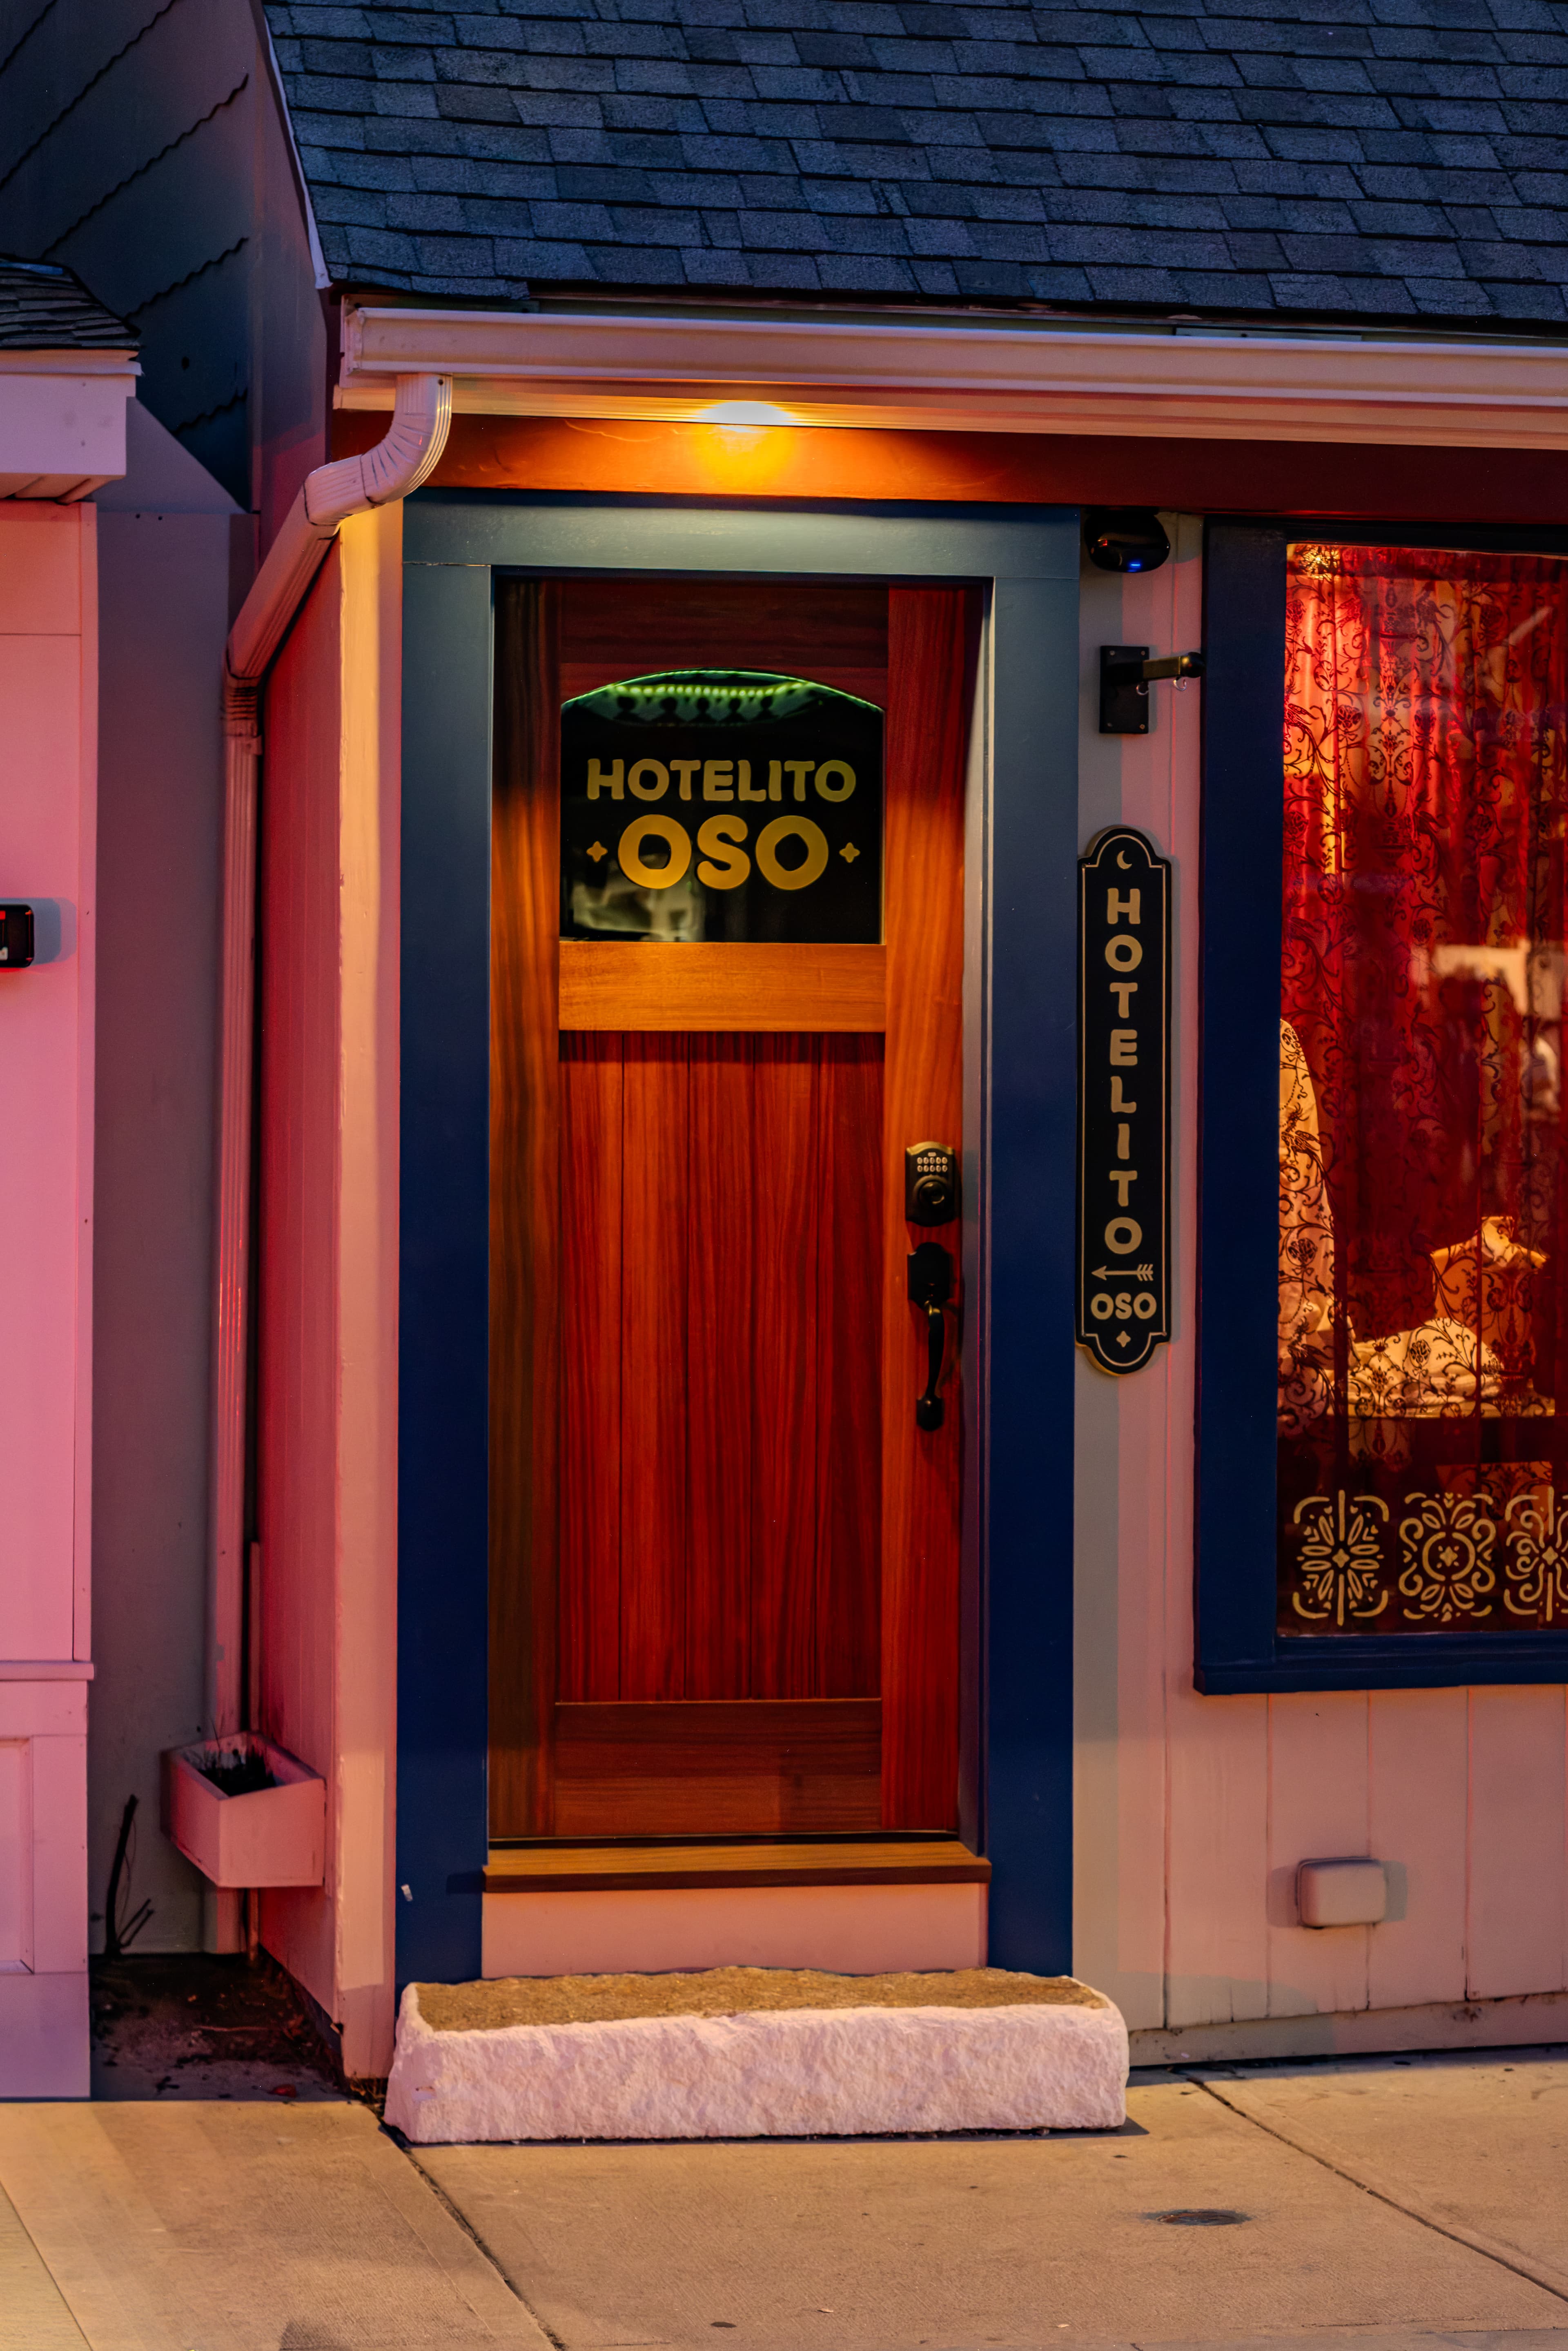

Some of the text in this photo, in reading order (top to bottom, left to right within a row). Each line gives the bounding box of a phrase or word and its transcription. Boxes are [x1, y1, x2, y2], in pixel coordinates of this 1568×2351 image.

[587, 758, 856, 802] HOTELITO
[618, 814, 829, 890] OSO
[1105, 888, 1143, 1255] HOTELITO
[1091, 1292, 1156, 1320] OSO
